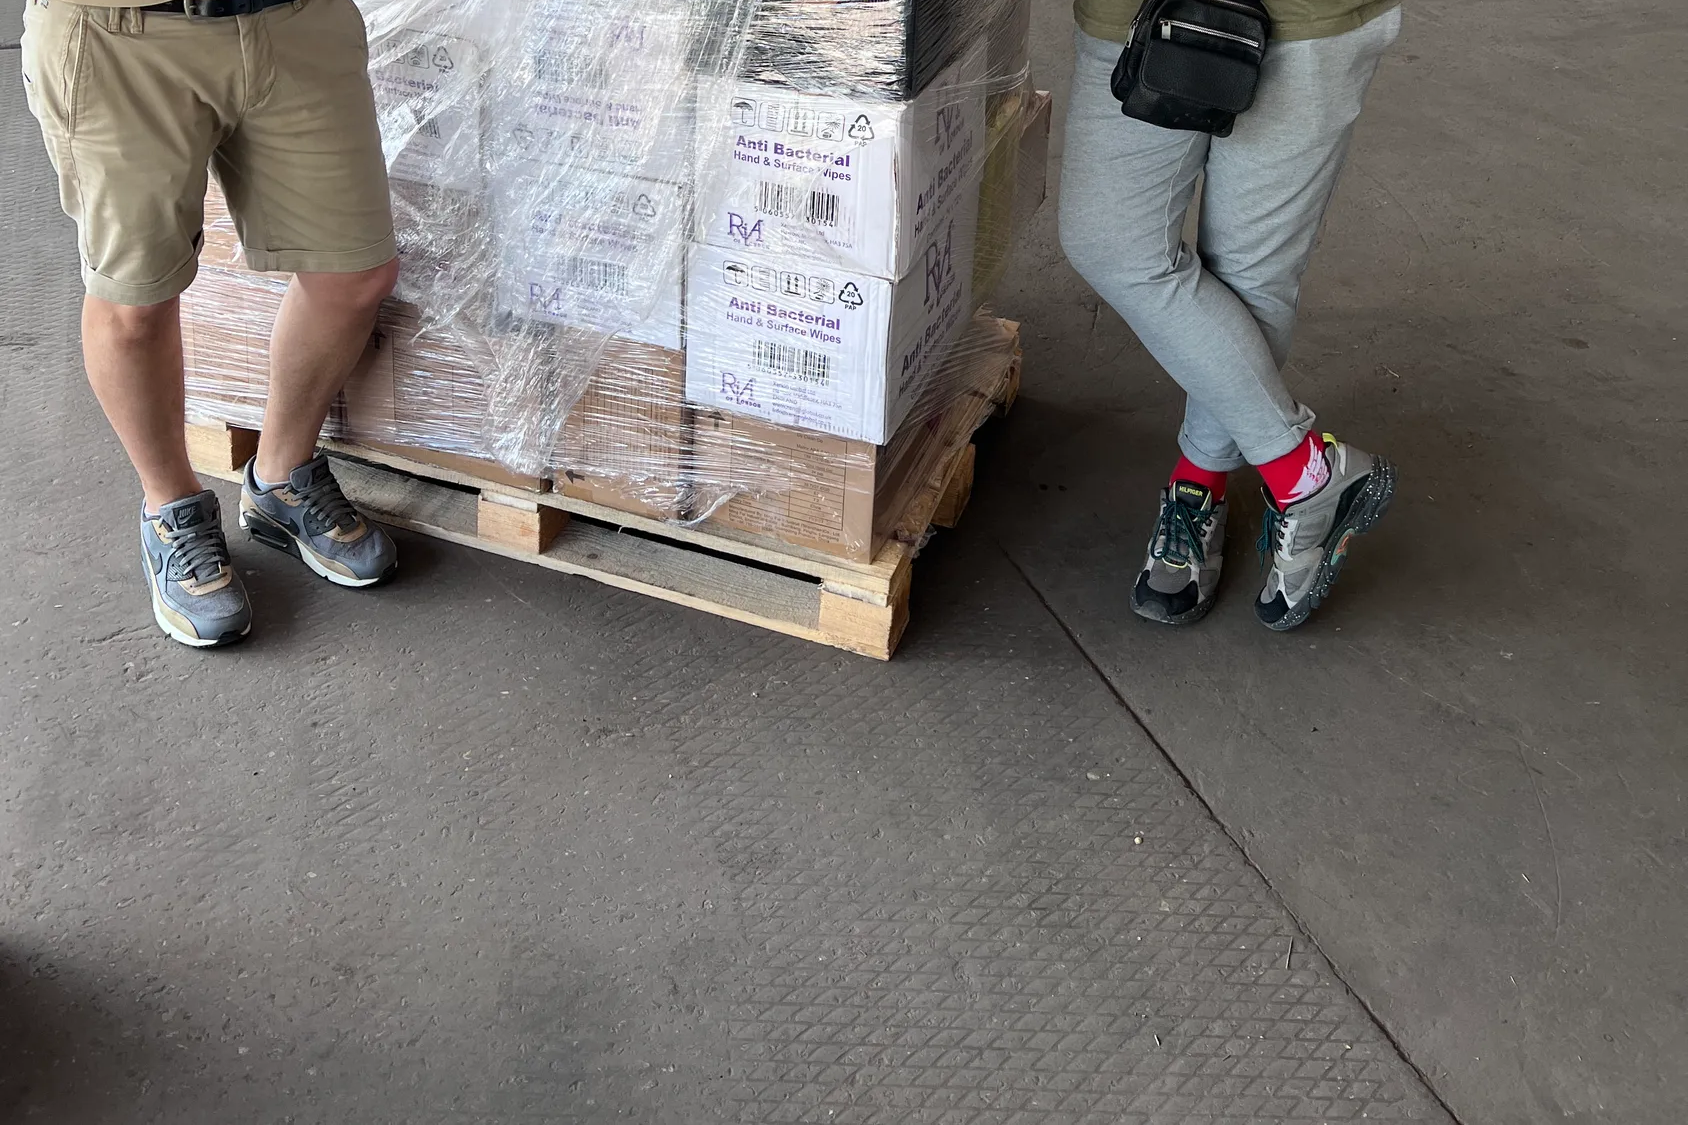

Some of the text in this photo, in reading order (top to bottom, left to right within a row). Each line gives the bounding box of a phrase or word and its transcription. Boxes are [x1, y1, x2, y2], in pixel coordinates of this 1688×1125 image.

[734, 150, 760, 164] Hand
[763, 156, 771, 166] &
[774, 159, 814, 174] Surface
[736, 135, 850, 167] Anti Bacterial
[916, 177, 936, 216] Anti
[937, 130, 973, 189] Bacterial
[847, 290, 856, 298] 20
[726, 311, 842, 344] Hand & Surface Wipes
[729, 297, 841, 331] Anti Bacterial
[901, 336, 922, 377] Anti
[924, 282, 963, 345] Bacterial
[1179, 485, 1203, 497] HILFIGER
[180, 506, 197, 518] NIKE
